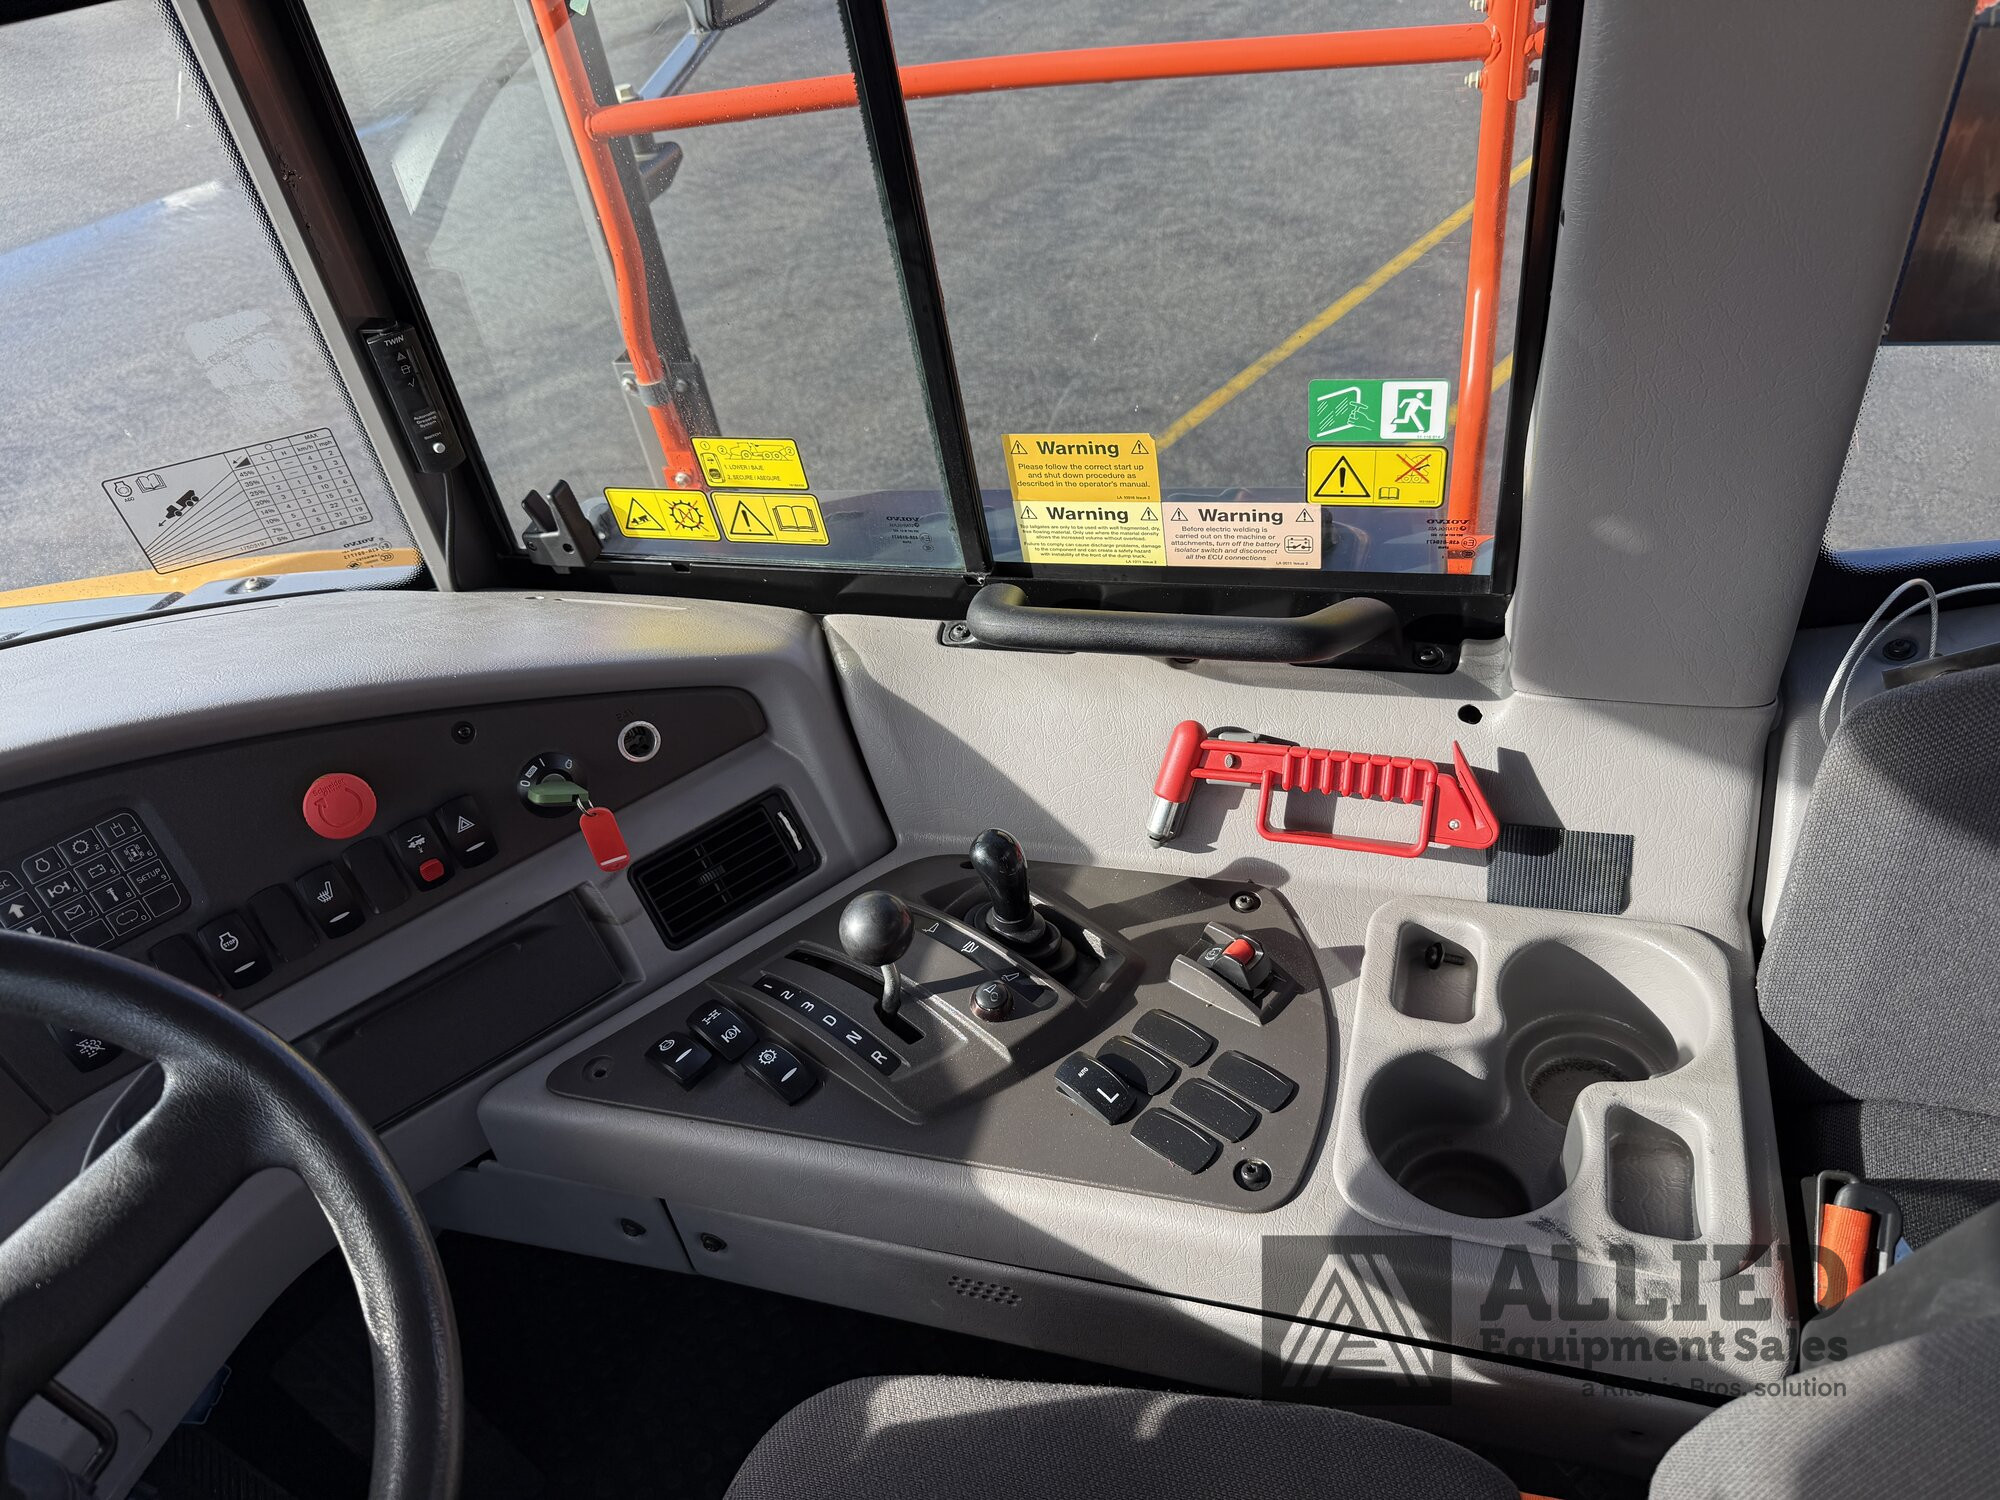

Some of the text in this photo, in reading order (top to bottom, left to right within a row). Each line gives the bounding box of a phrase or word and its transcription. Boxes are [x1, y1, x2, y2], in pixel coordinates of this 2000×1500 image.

[384, 334, 404, 346] TWIN
[1036, 441, 1119, 458] Warning
[1046, 507, 1128, 523] Warning
[1198, 509, 1283, 524] Warning
[136, 868, 161, 884] SETUP
[223, 939, 235, 948] STOP
[780, 990, 794, 1000] 2
[800, 1001, 815, 1012] 3
[822, 1015, 837, 1026] D
[846, 1030, 862, 1044] N
[871, 1050, 888, 1064] R
[1078, 1067, 1089, 1078] AUTO
